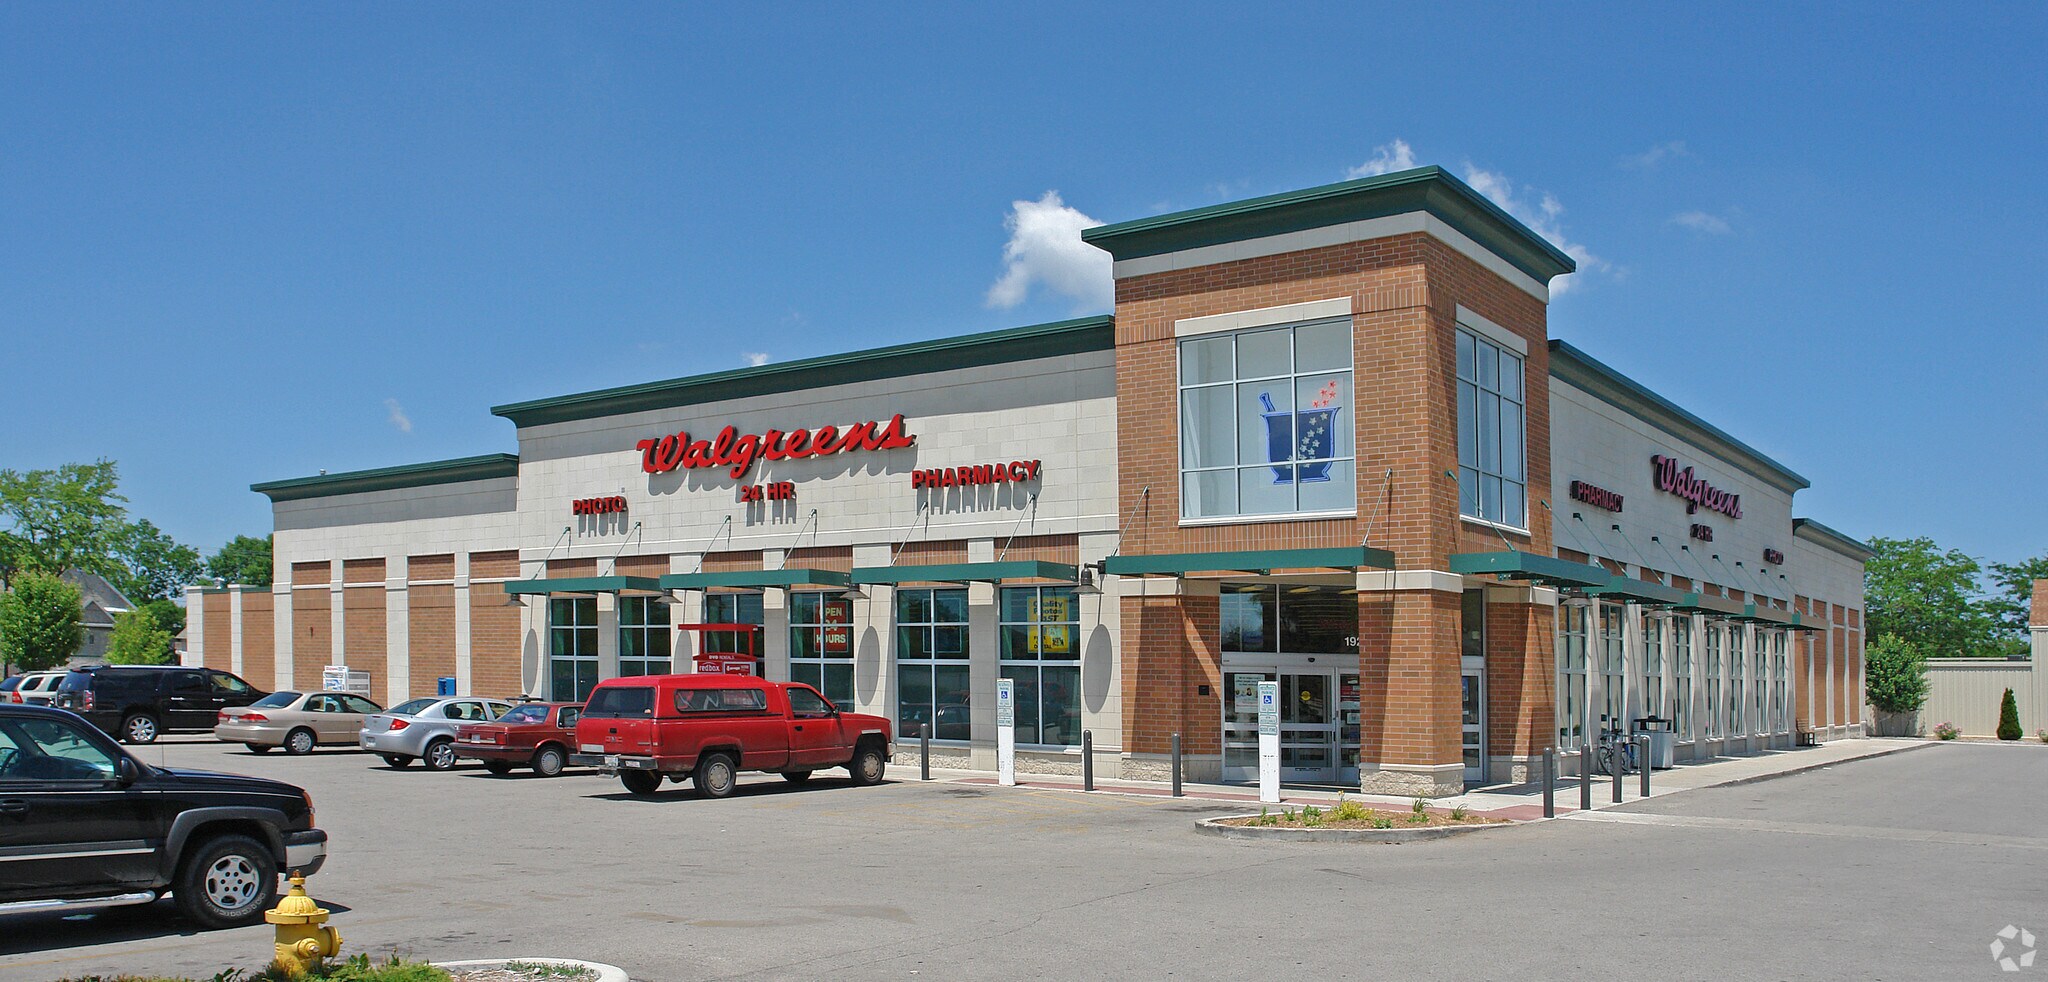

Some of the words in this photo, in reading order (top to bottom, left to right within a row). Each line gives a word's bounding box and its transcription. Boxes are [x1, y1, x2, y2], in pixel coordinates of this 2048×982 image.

[637, 413, 916, 480] Walgreens
[912, 459, 1041, 489] PHARMACY
[1651, 454, 1743, 518] Walgreens
[572, 496, 627, 515] PHOTO
[741, 485, 764, 502] 24
[767, 482, 796, 501] HR
[1571, 480, 1624, 512] PHARMACY
[1033, 601, 1063, 609] Qality
